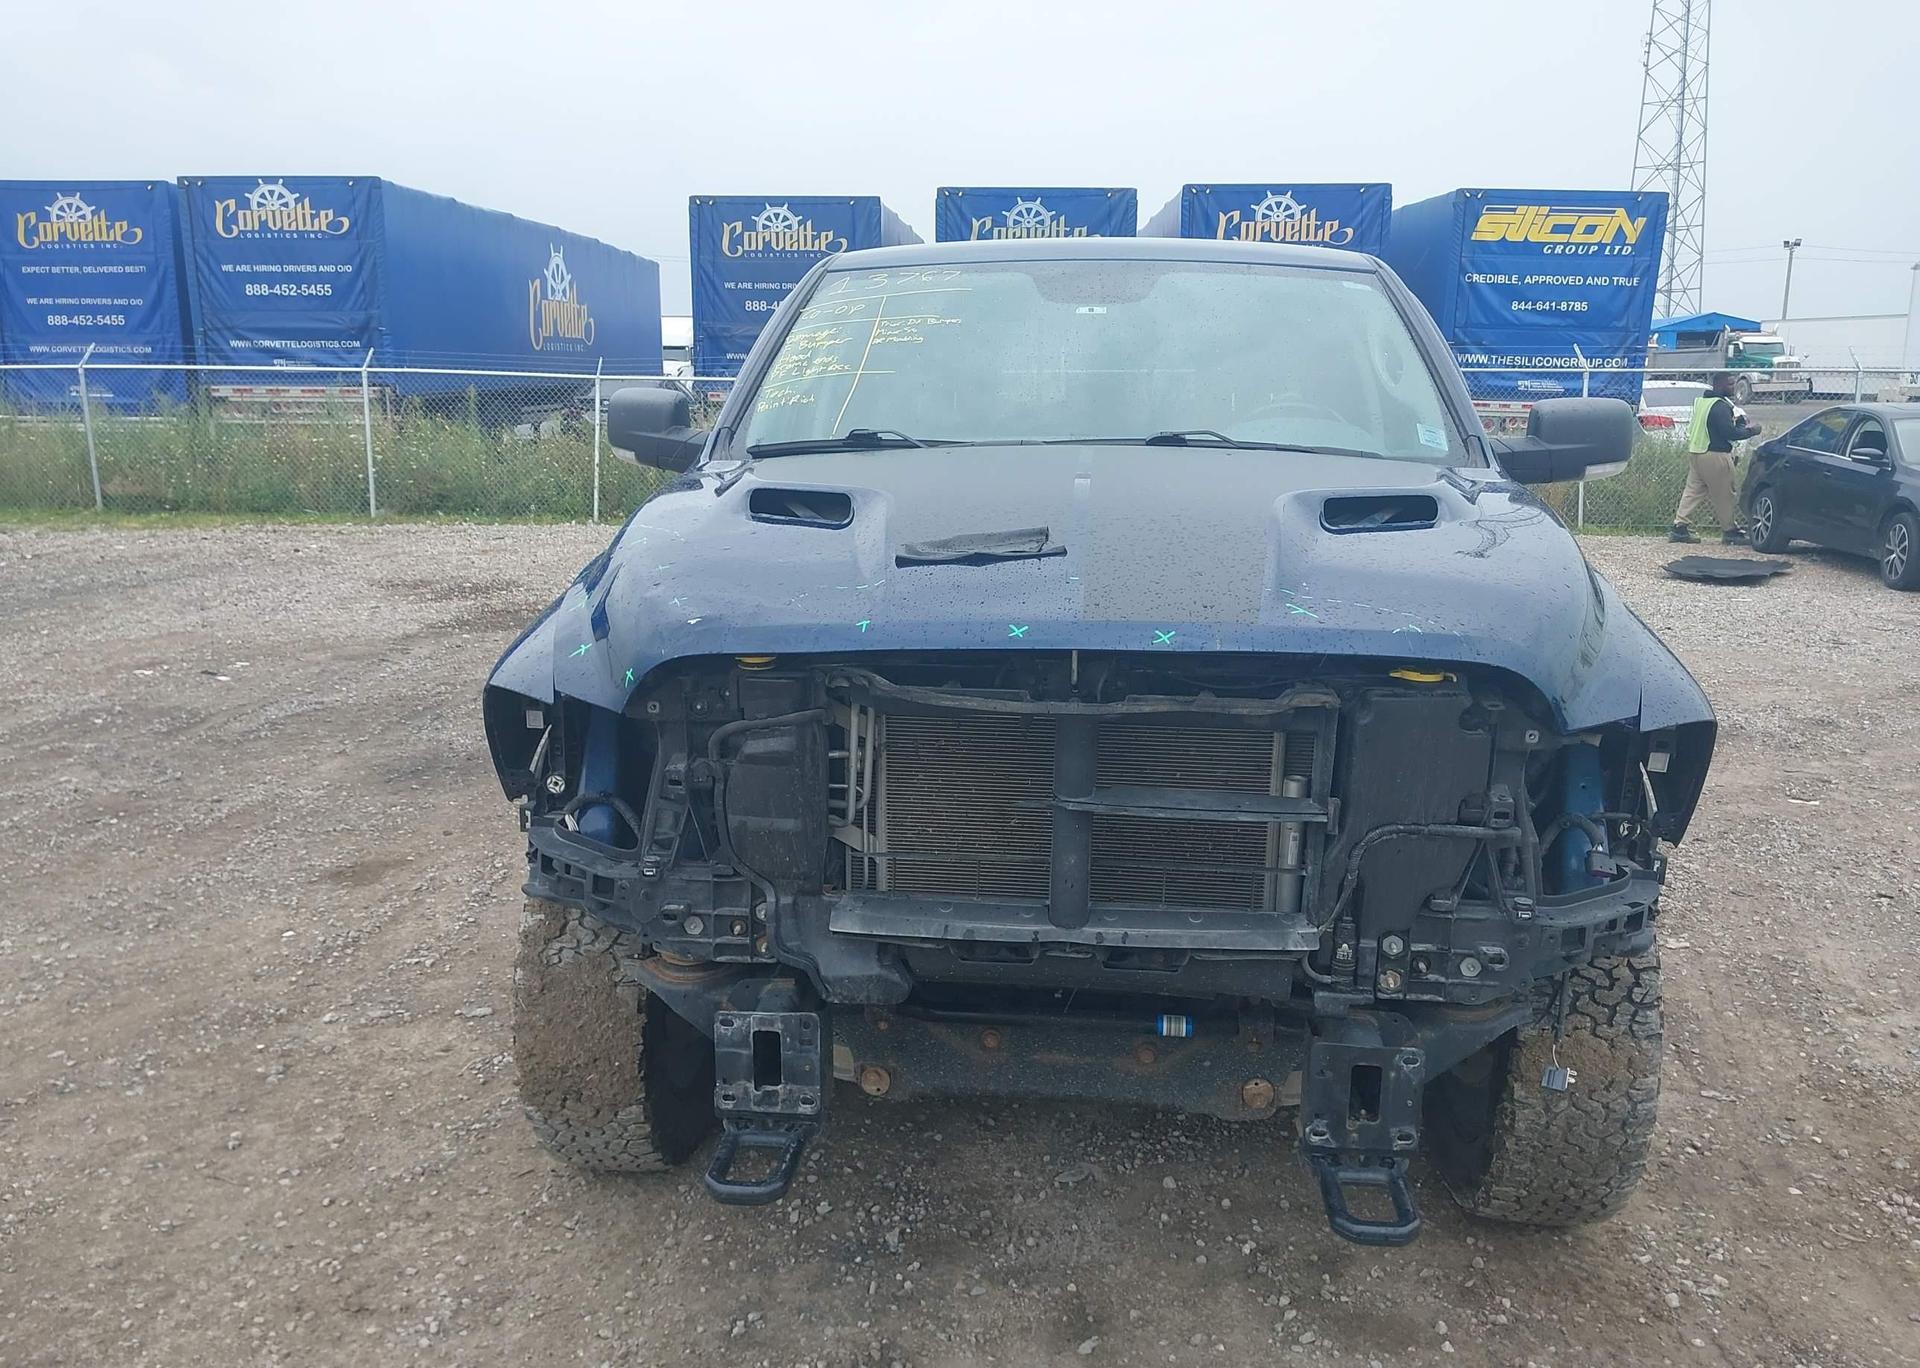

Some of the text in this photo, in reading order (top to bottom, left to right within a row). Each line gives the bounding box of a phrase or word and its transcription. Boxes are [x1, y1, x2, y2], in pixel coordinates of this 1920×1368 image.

[214, 197, 350, 238] Corvette
[16, 209, 143, 249] Corvette
[1216, 207, 1354, 245] Corvette
[721, 219, 848, 258] Corvette
[1543, 244, 1635, 255] GROUP LTD.
[22, 265, 50, 274] EXPECT
[51, 265, 82, 275] BETTER,
[82, 265, 124, 274] DELIVERED
[221, 264, 235, 273] WE
[235, 264, 252, 273] ARE
[253, 264, 282, 273] HIRING
[282, 264, 318, 273] DRIVERS
[318, 264, 336, 273] AND
[1465, 273, 1640, 286] CREDIBLE, APPROVED AND TRUE
[245, 284, 332, 296] 888-452-5455
[723, 281, 737, 290] WE
[737, 281, 753, 290] ARE
[754, 282, 781, 290] HIRING
[55, 298, 80, 306] HIRING
[81, 298, 112, 306] DRIVERS
[113, 298, 129, 306] AND
[745, 300, 780, 311] 888-4
[1511, 300, 1588, 311] 844-641-8785
[47, 315, 125, 326] 888-452-5455
[229, 339, 361, 349] WWW.CORVETTELOGISTICS.COM
